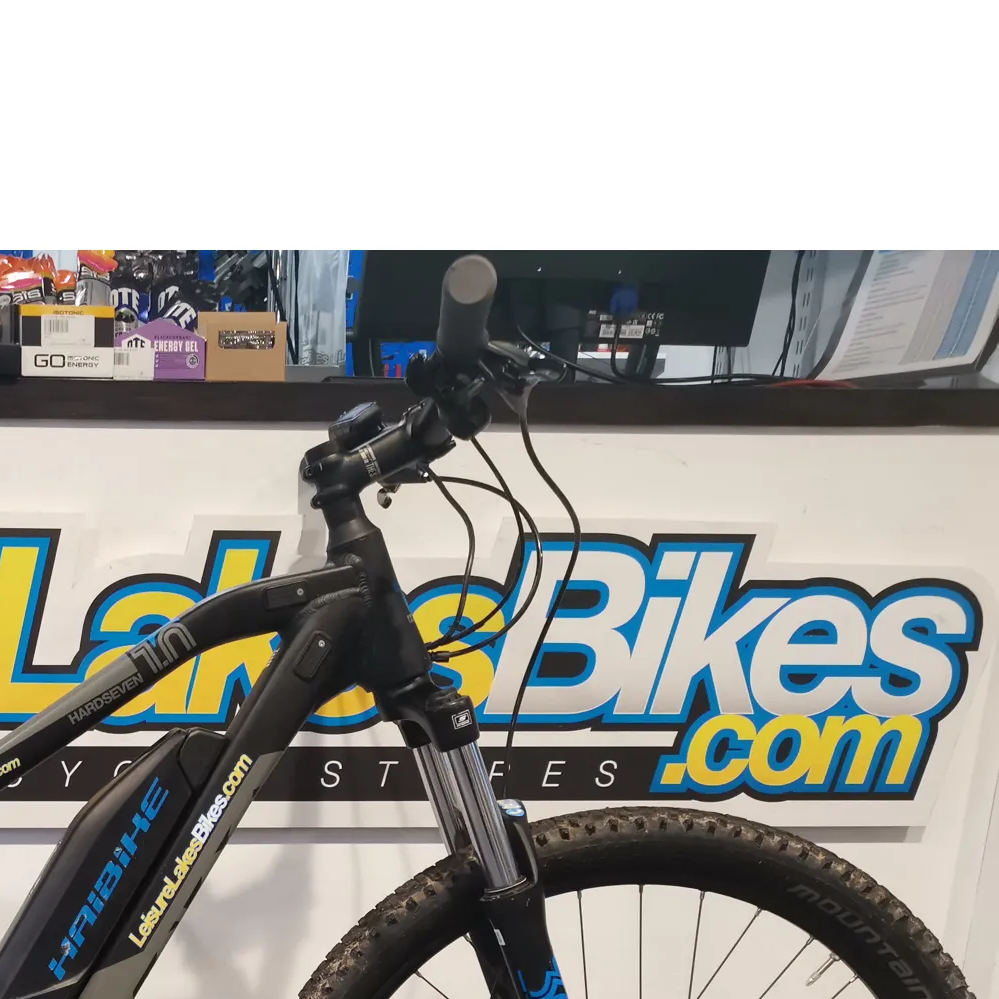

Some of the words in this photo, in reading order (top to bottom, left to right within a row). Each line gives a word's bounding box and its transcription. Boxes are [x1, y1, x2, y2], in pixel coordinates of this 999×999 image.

[157, 285, 179, 313] OT
[34, 354, 66, 368] GO
[154, 340, 183, 352] ENERGY
[185, 341, 199, 352] GEL
[68, 673, 144, 725] HARDSEVEN
[653, 711, 930, 794] .com
[320, 759, 618, 789] STES
[128, 754, 253, 948] LeisureLakesBikes.com
